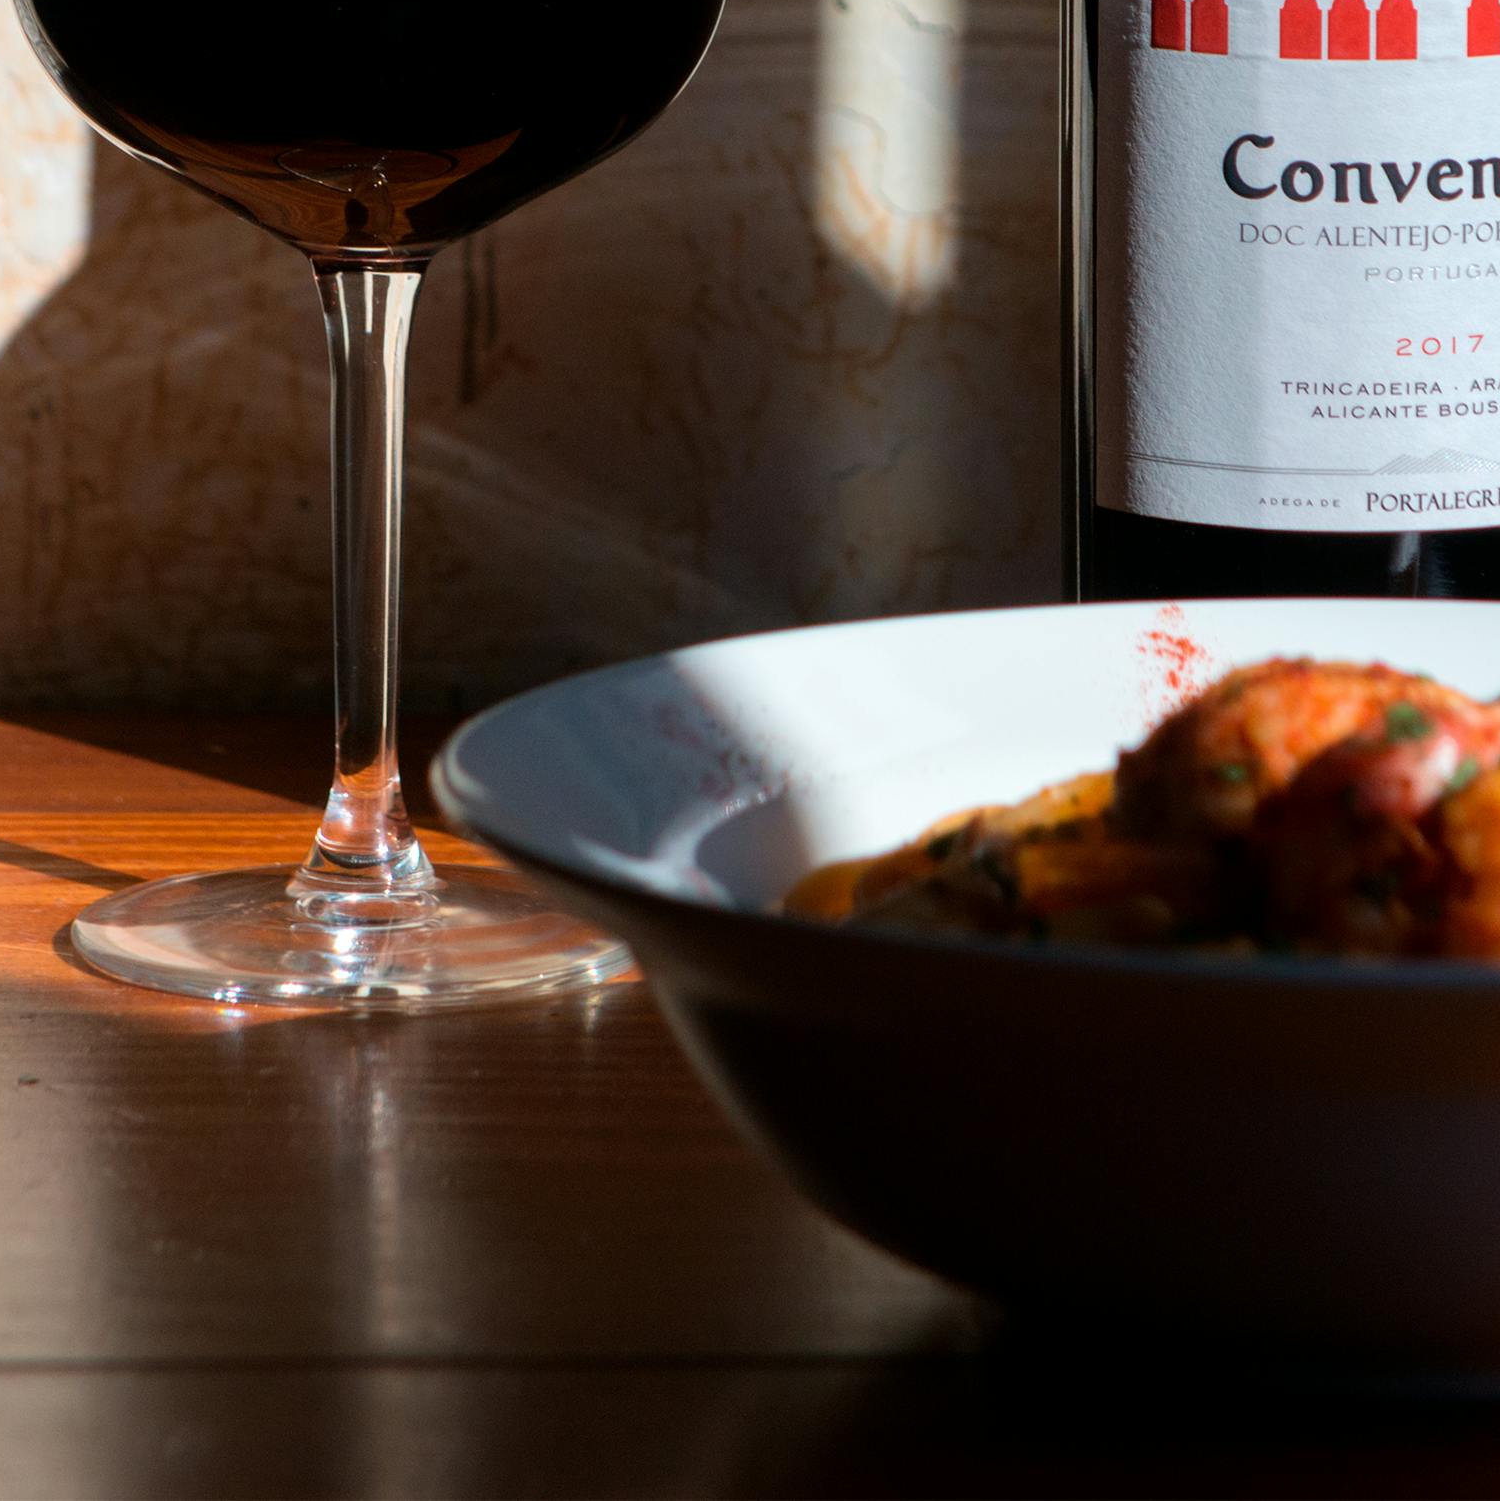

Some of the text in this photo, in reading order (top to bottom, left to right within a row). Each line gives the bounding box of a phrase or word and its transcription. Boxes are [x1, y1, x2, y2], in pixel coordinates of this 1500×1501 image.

[1239, 222, 1305, 245] DOC
[1395, 334, 1485, 356] 2017
[1280, 381, 1443, 395] TRINCADEIRA
[1311, 405, 1428, 419] ALICANTE
[1258, 498, 1314, 507] ADEGA
[1320, 500, 1341, 508] DE
